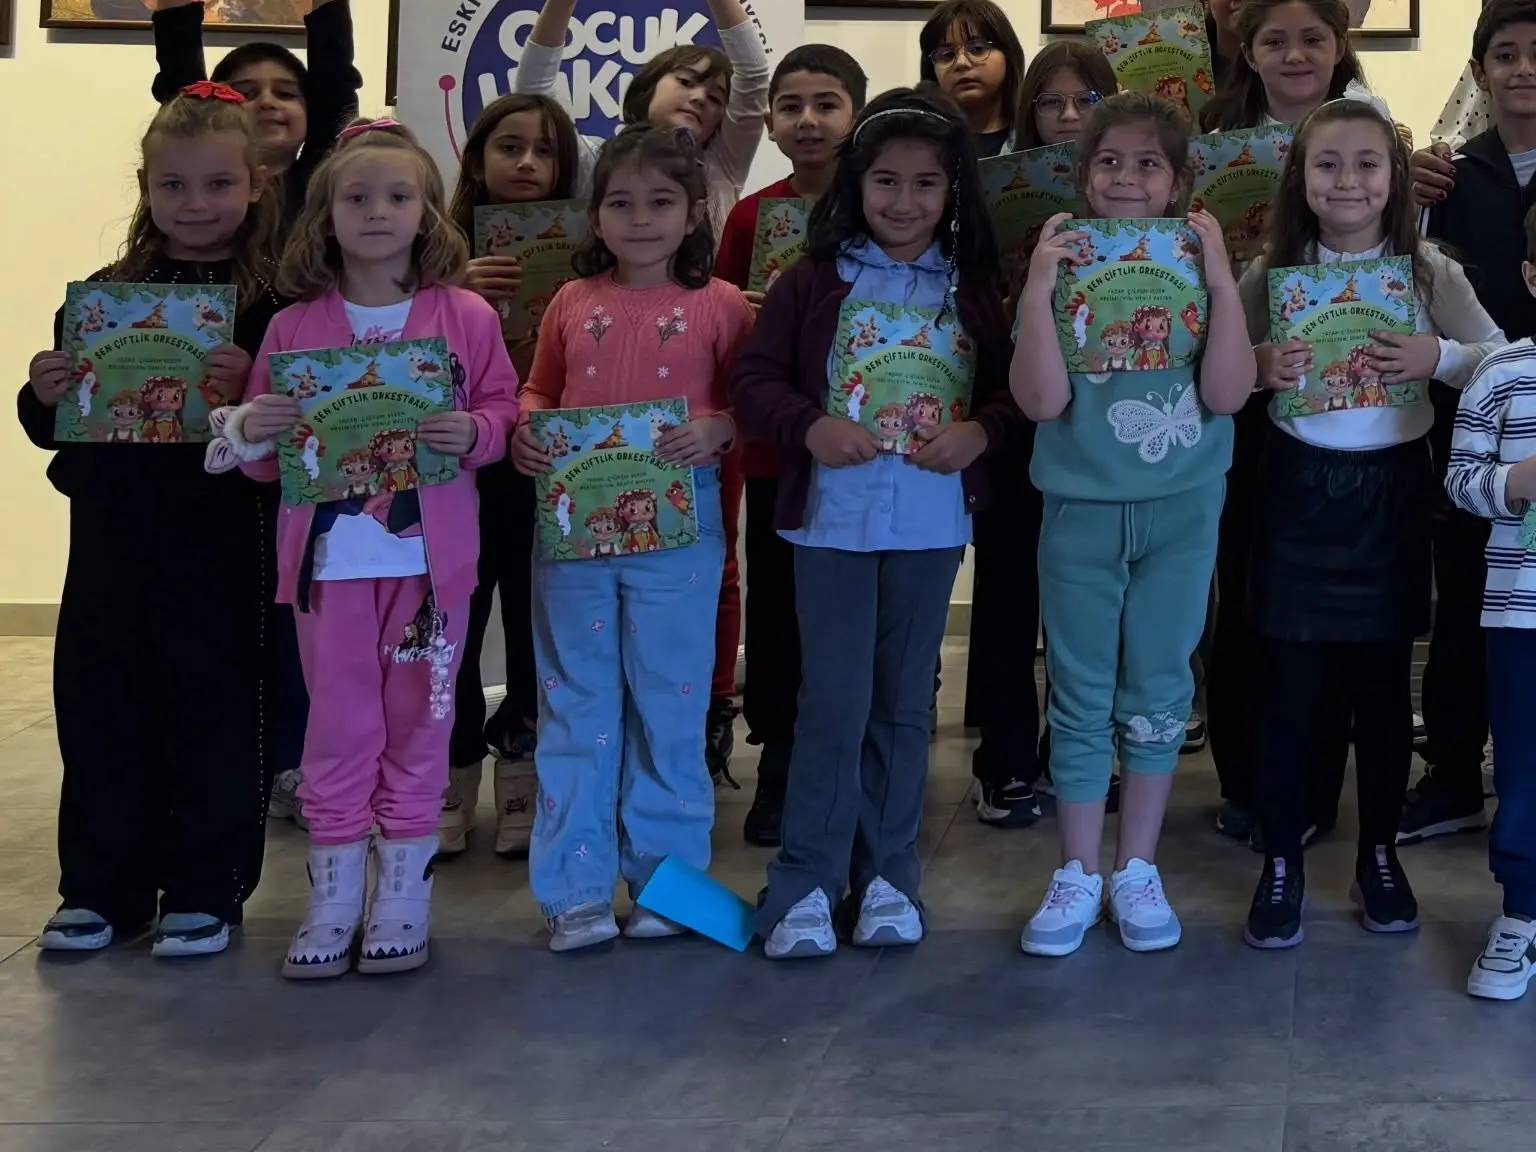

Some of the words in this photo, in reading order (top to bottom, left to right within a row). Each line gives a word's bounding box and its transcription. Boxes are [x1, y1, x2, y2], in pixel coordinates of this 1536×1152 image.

[1087, 278, 1104, 293] ŞEN
[1104, 267, 1137, 283] ÇİFTLİK
[1139, 267, 1187, 292] ORKESTRASI
[1302, 322, 1318, 337] ŞEN
[1317, 309, 1348, 325] ÇİFTLİK
[1350, 308, 1397, 328] ORKESTRASI
[95, 345, 113, 361] ŞEN
[114, 334, 150, 350] ÇİFTLİK
[884, 352, 916, 365] ÇİFTLİK
[918, 354, 959, 384] ORKESTRASI
[313, 408, 333, 424] ŞEN
[332, 394, 369, 412] ÇİFTLİK
[372, 392, 430, 412] ORKESTRASI
[581, 454, 614, 471] ÇİFTLİK
